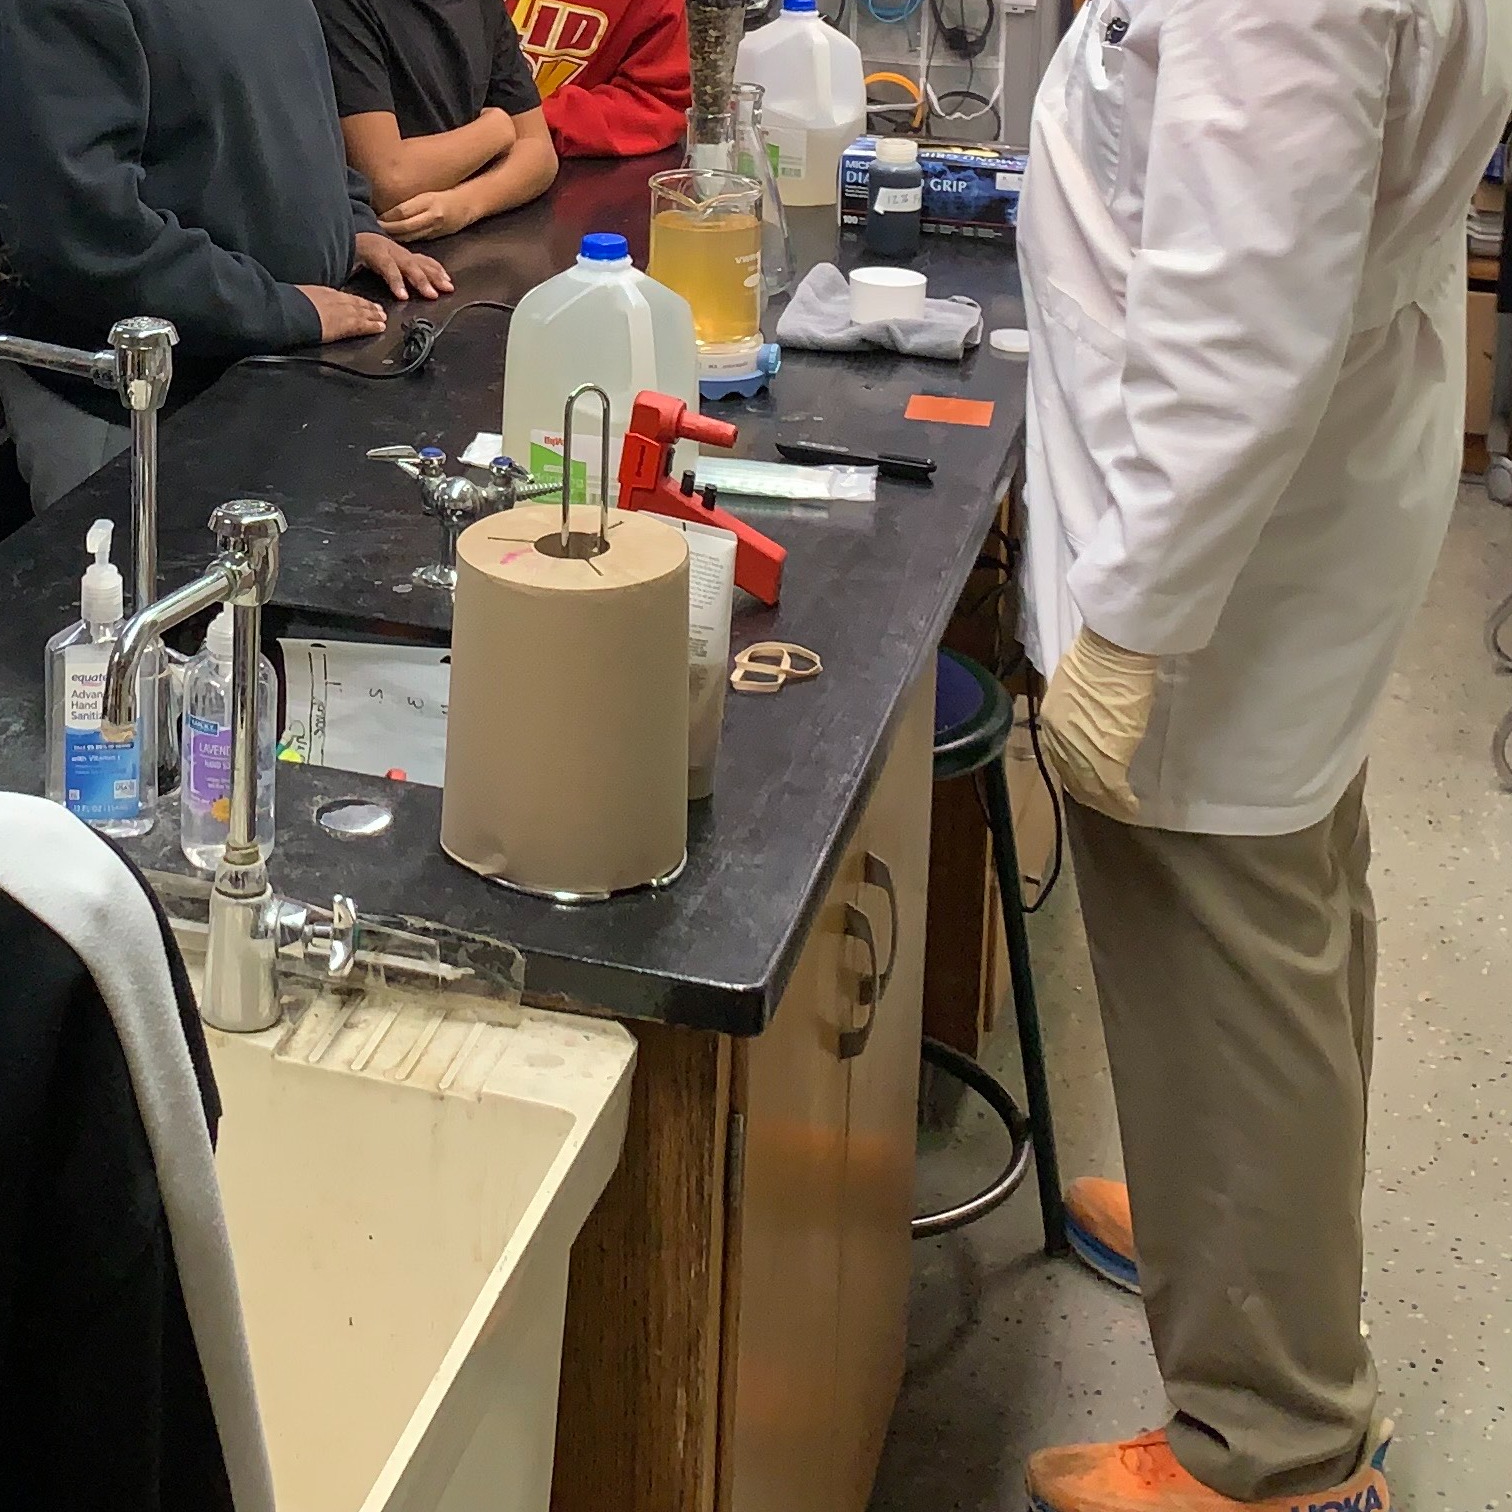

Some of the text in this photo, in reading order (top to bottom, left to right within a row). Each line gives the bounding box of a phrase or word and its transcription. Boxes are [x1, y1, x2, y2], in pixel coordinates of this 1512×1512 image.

[929, 178, 967, 192] GRIP
[71, 701, 97, 710] Hand
[71, 711, 104, 720] Sanitiz
